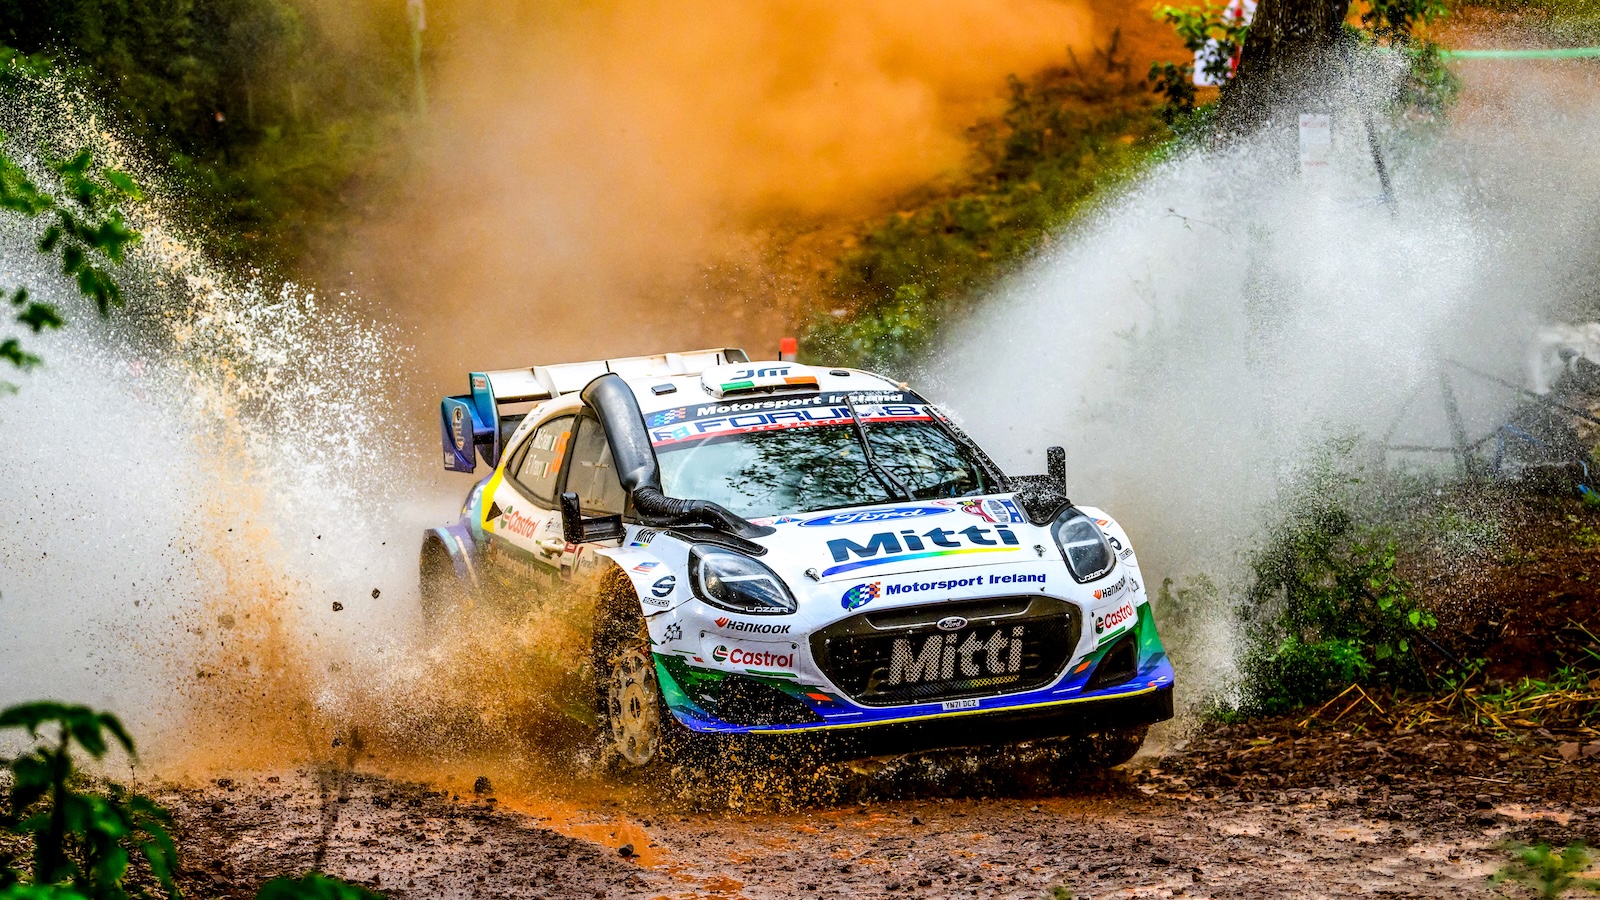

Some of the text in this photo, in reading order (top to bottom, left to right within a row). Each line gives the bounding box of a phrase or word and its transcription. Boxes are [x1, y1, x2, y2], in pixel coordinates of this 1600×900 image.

[696, 393, 904, 417] Motorsport Ireland
[507, 510, 541, 539] Castrol
[829, 508, 927, 525] Ford
[826, 524, 1020, 563] Mitti
[886, 573, 1046, 596] Motorsport Ireland
[1104, 601, 1134, 629] Castrol
[729, 648, 794, 668] Castrol
[888, 626, 1024, 686] Mitti
